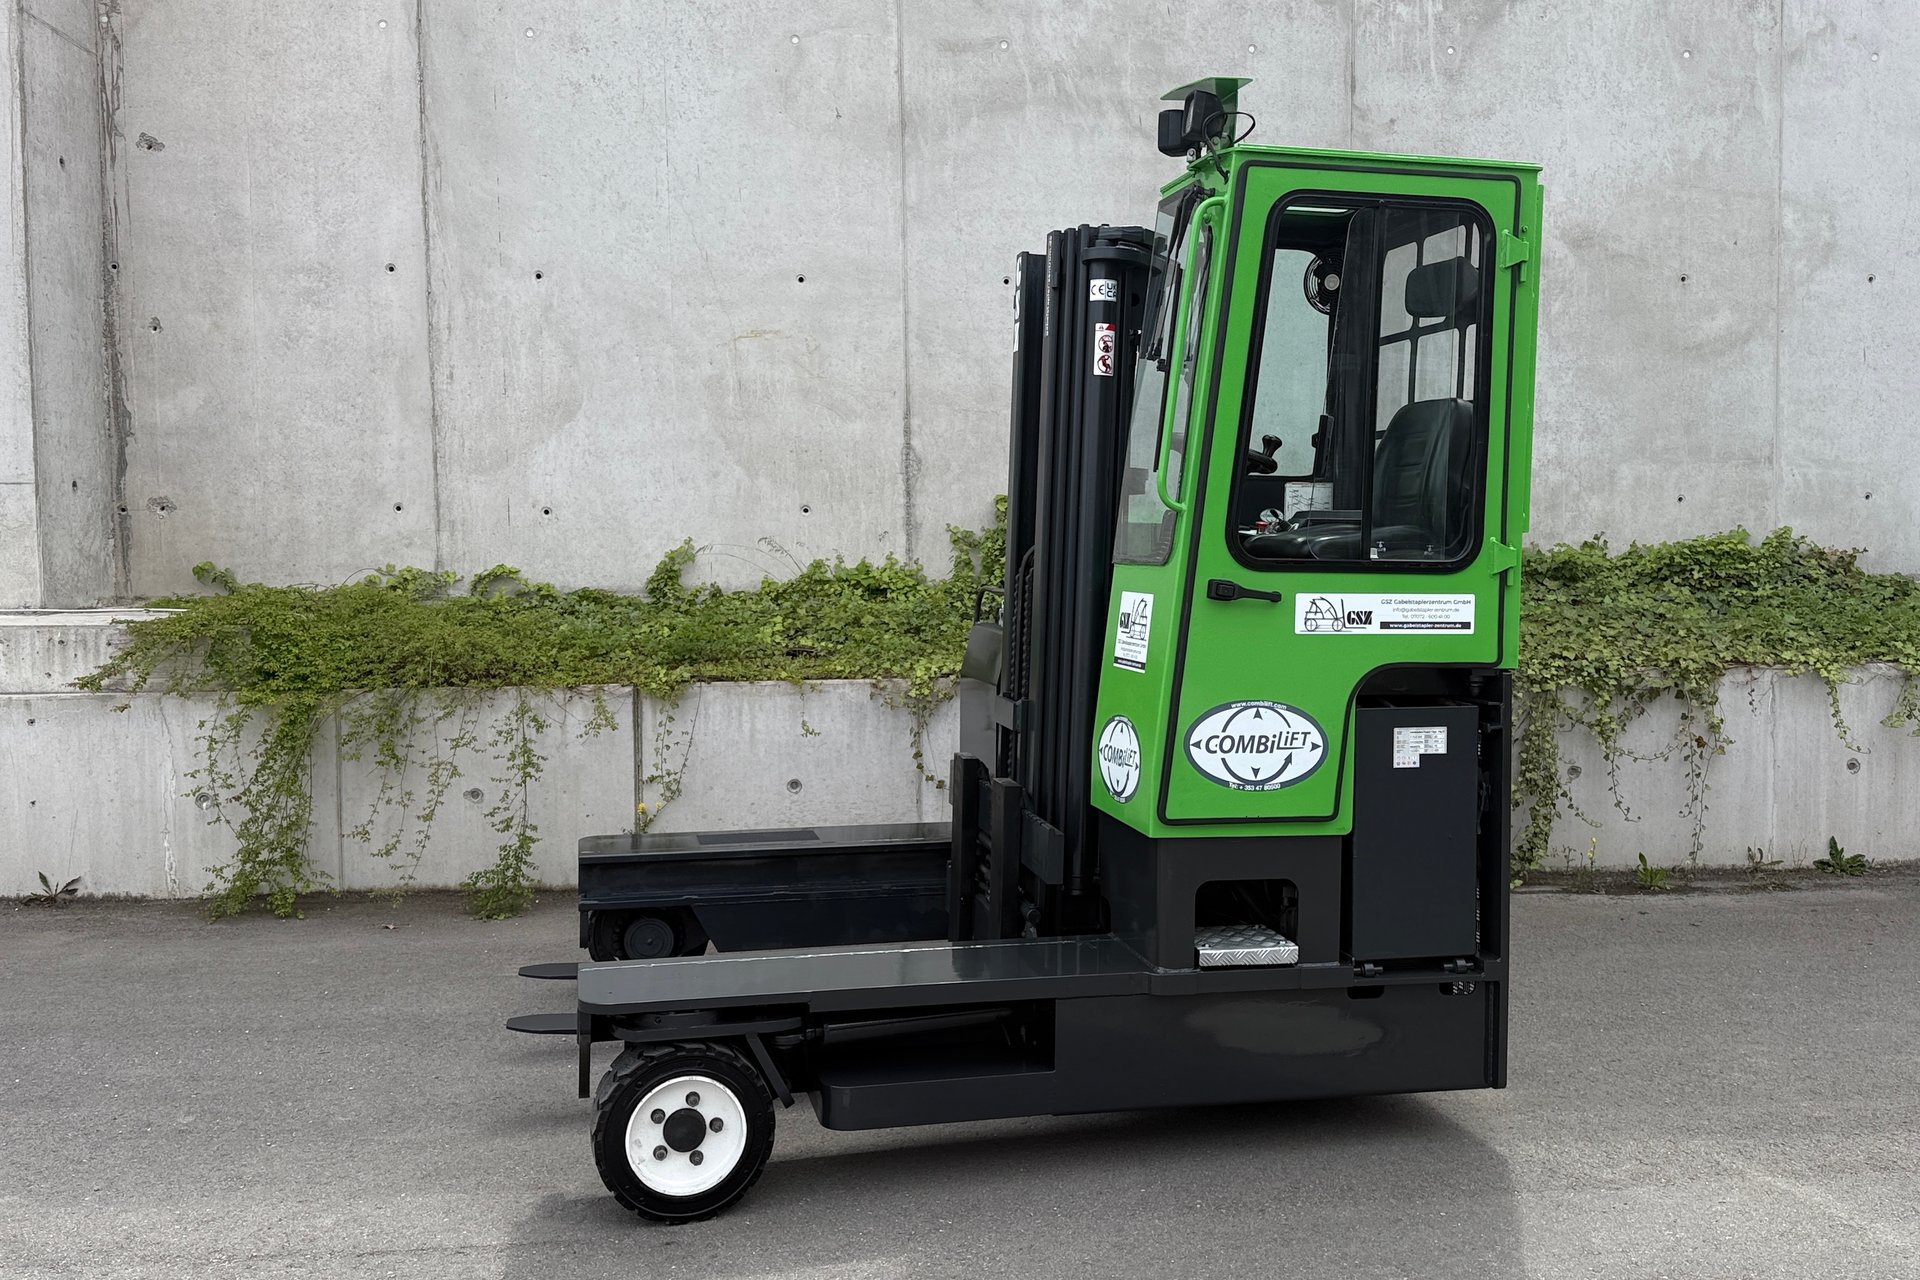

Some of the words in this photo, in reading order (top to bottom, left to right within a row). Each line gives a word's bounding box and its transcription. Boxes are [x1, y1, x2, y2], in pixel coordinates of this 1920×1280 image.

[1393, 598, 1452, 606] Gabelstaplerzentrum
[1346, 610, 1373, 625] GSZ
[1231, 700, 1287, 710] www.combilift.com
